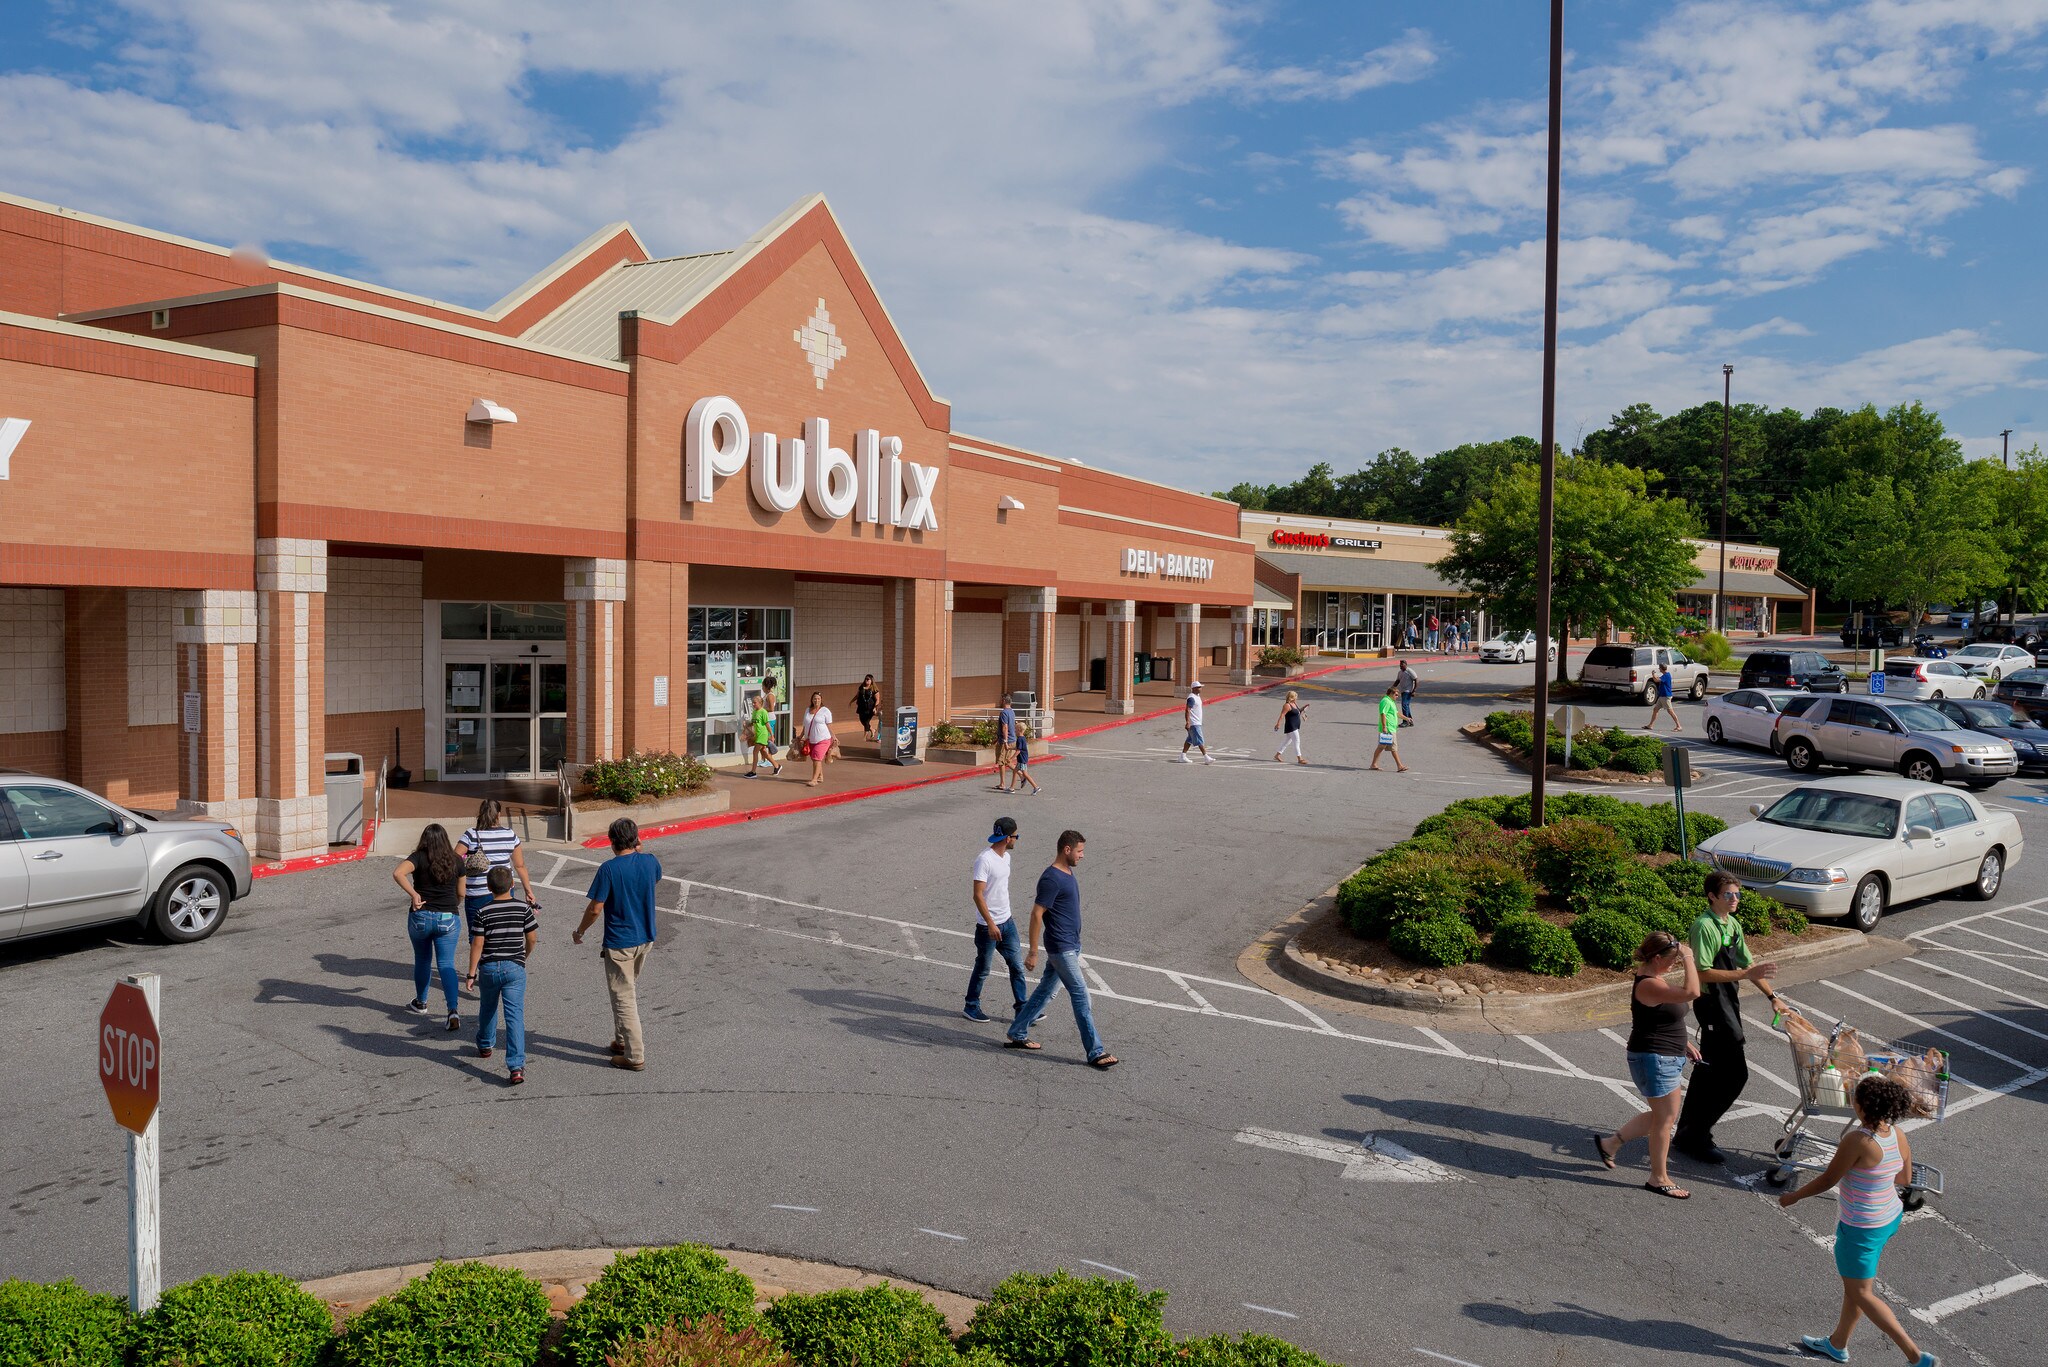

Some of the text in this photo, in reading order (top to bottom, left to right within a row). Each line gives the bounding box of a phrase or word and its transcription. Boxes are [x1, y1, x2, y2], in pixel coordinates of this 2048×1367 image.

[686, 395, 940, 532] Publix
[1335, 538, 1380, 548] GRILLE
[1121, 548, 1215, 579] DELI BAKERY
[709, 650, 731, 660] 4430
[102, 1024, 156, 1091] STOP
